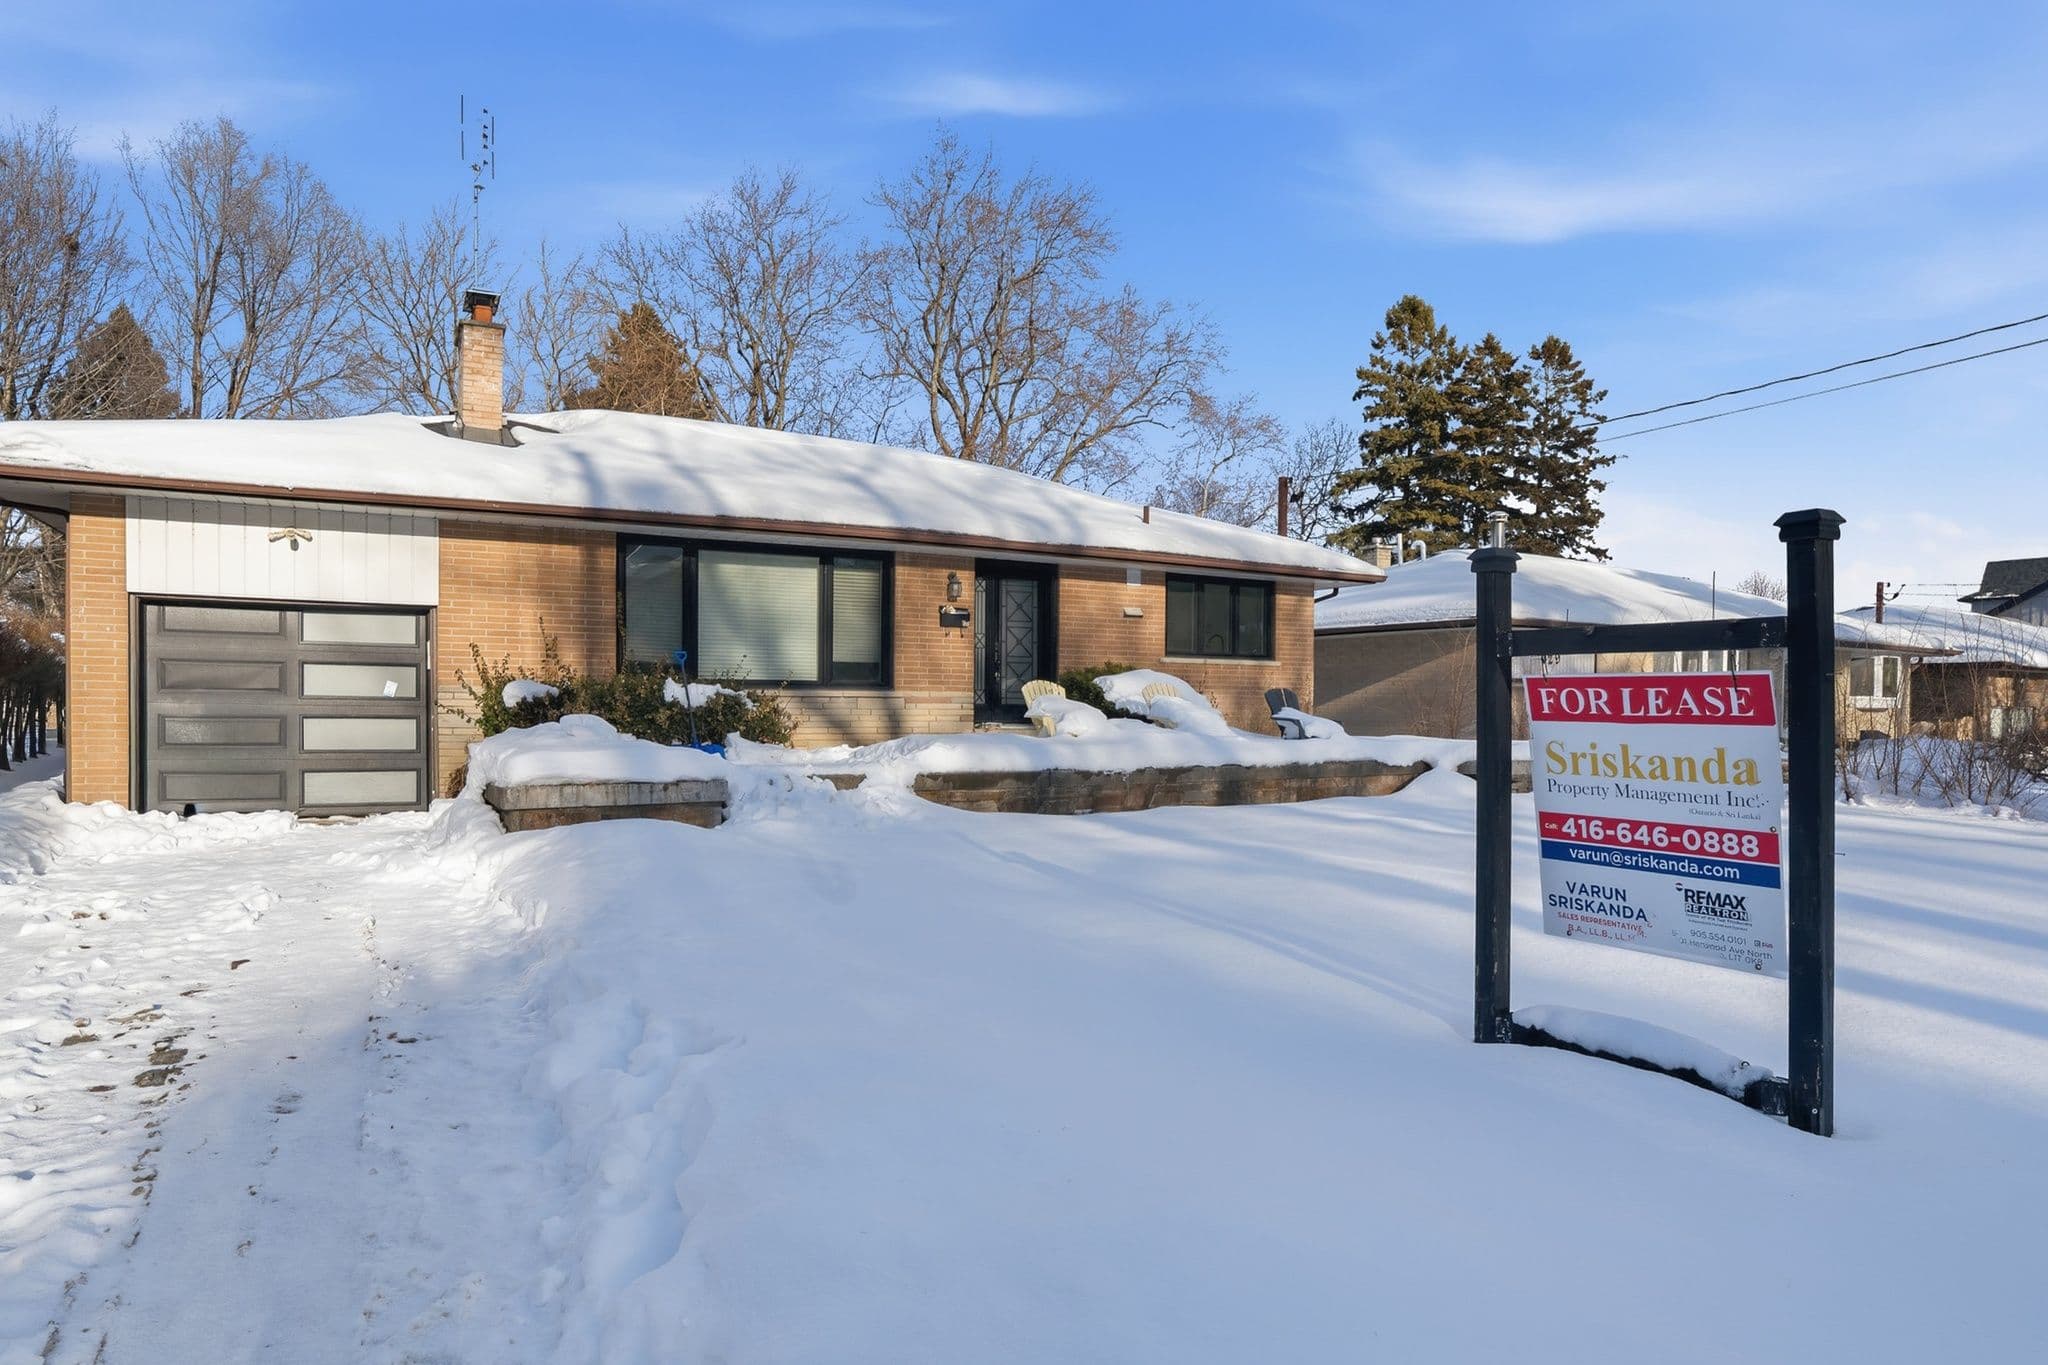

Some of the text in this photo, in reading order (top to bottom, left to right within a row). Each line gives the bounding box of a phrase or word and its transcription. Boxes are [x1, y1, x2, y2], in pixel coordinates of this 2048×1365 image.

[1538, 686, 1755, 717] FOR LEASE
[1545, 741, 1762, 785] Sriskanda
[1547, 778, 1610, 799] Property
[1615, 783, 1721, 806] Management
[1561, 817, 1760, 858] 416-646-0888
[1569, 848, 1740, 879] varun@sriskanda.com
[1565, 881, 1627, 902] VARUN
[1684, 889, 1747, 911] REMAX
[1548, 894, 1648, 922] SRISKANDA
[1557, 911, 1579, 921] SALES
[1685, 904, 1749, 921] REALTRON
[1729, 946, 1745, 956] Ave
[1747, 950, 1773, 960] North
